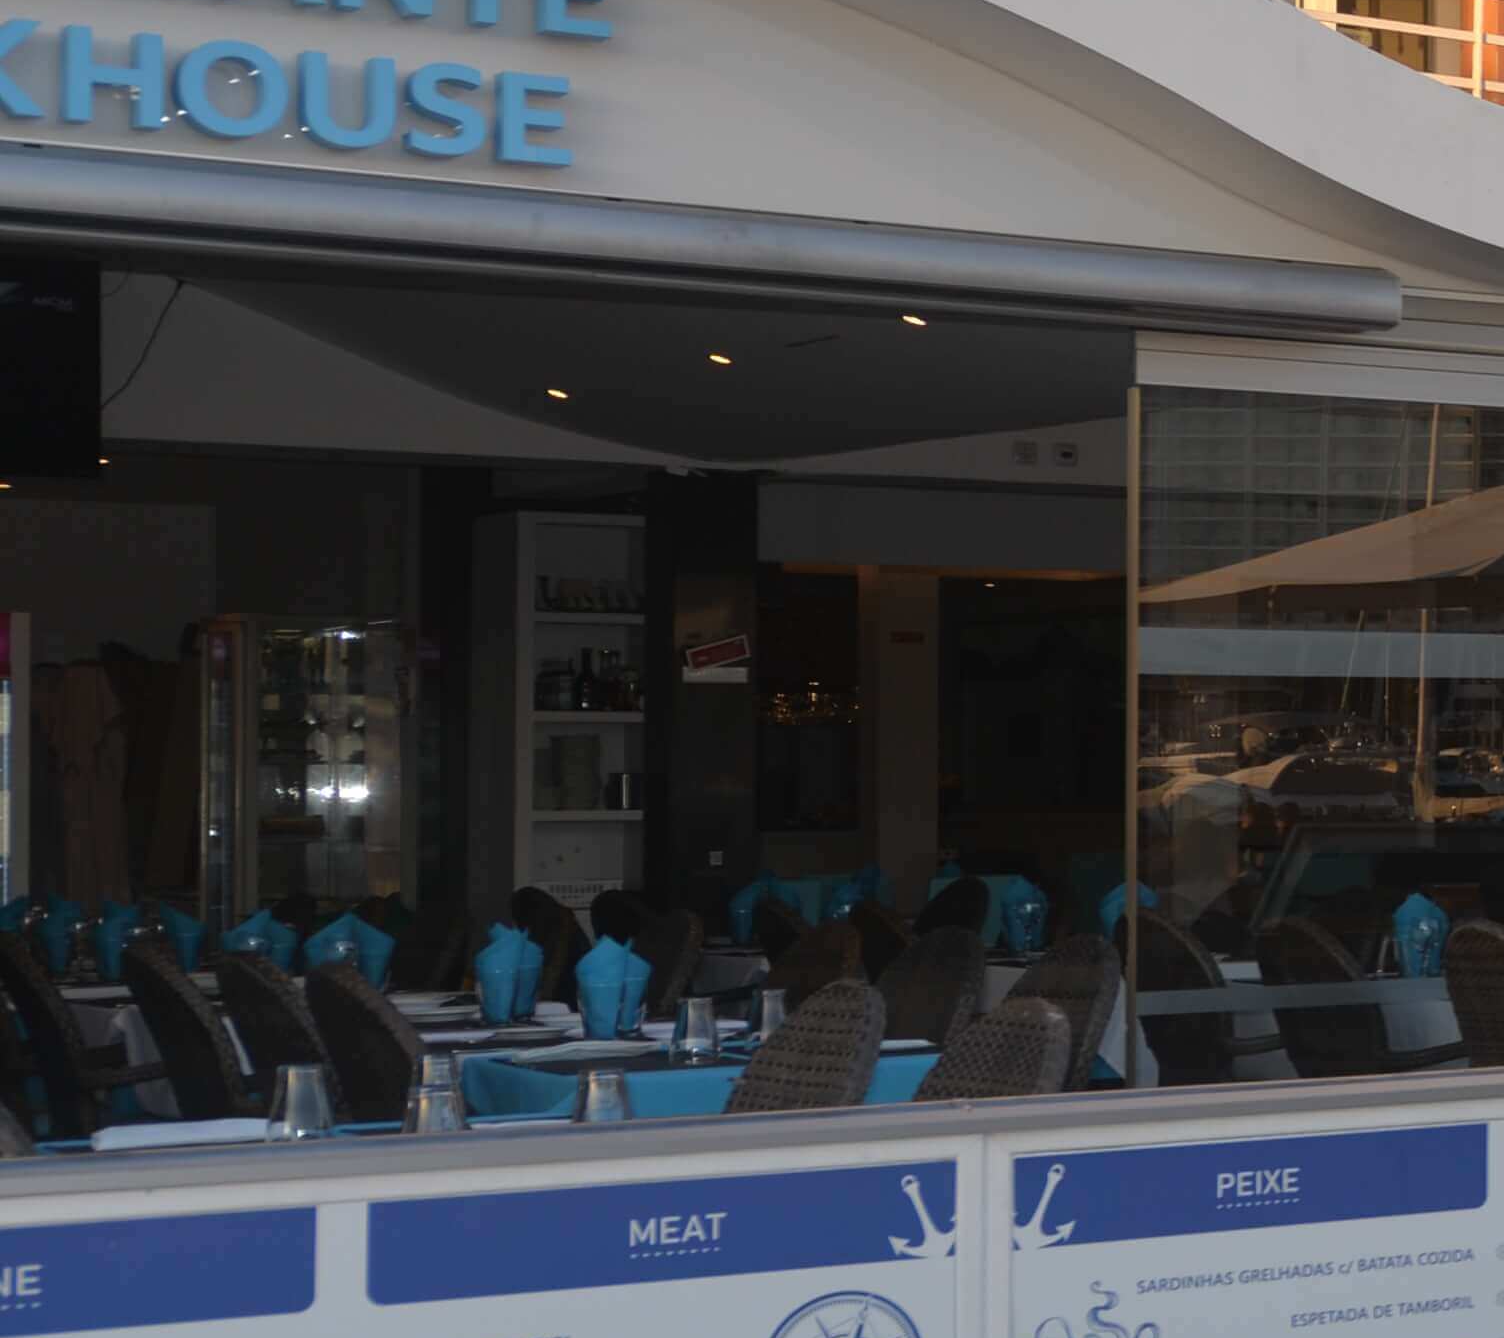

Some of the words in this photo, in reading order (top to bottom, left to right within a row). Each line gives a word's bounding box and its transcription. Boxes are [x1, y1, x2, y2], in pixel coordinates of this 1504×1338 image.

[1216, 1167, 1301, 1199] PEIXE
[628, 1211, 728, 1249] MEAT
[1137, 1271, 1235, 1294] SARDINHAS
[1240, 1261, 1334, 1285] GRELHADAS
[1357, 1254, 1413, 1272] BATATA
[1417, 1248, 1475, 1266] COZIDA
[1291, 1307, 1369, 1328] ESPETADA
[1396, 1296, 1473, 1317] TAMBORIL
